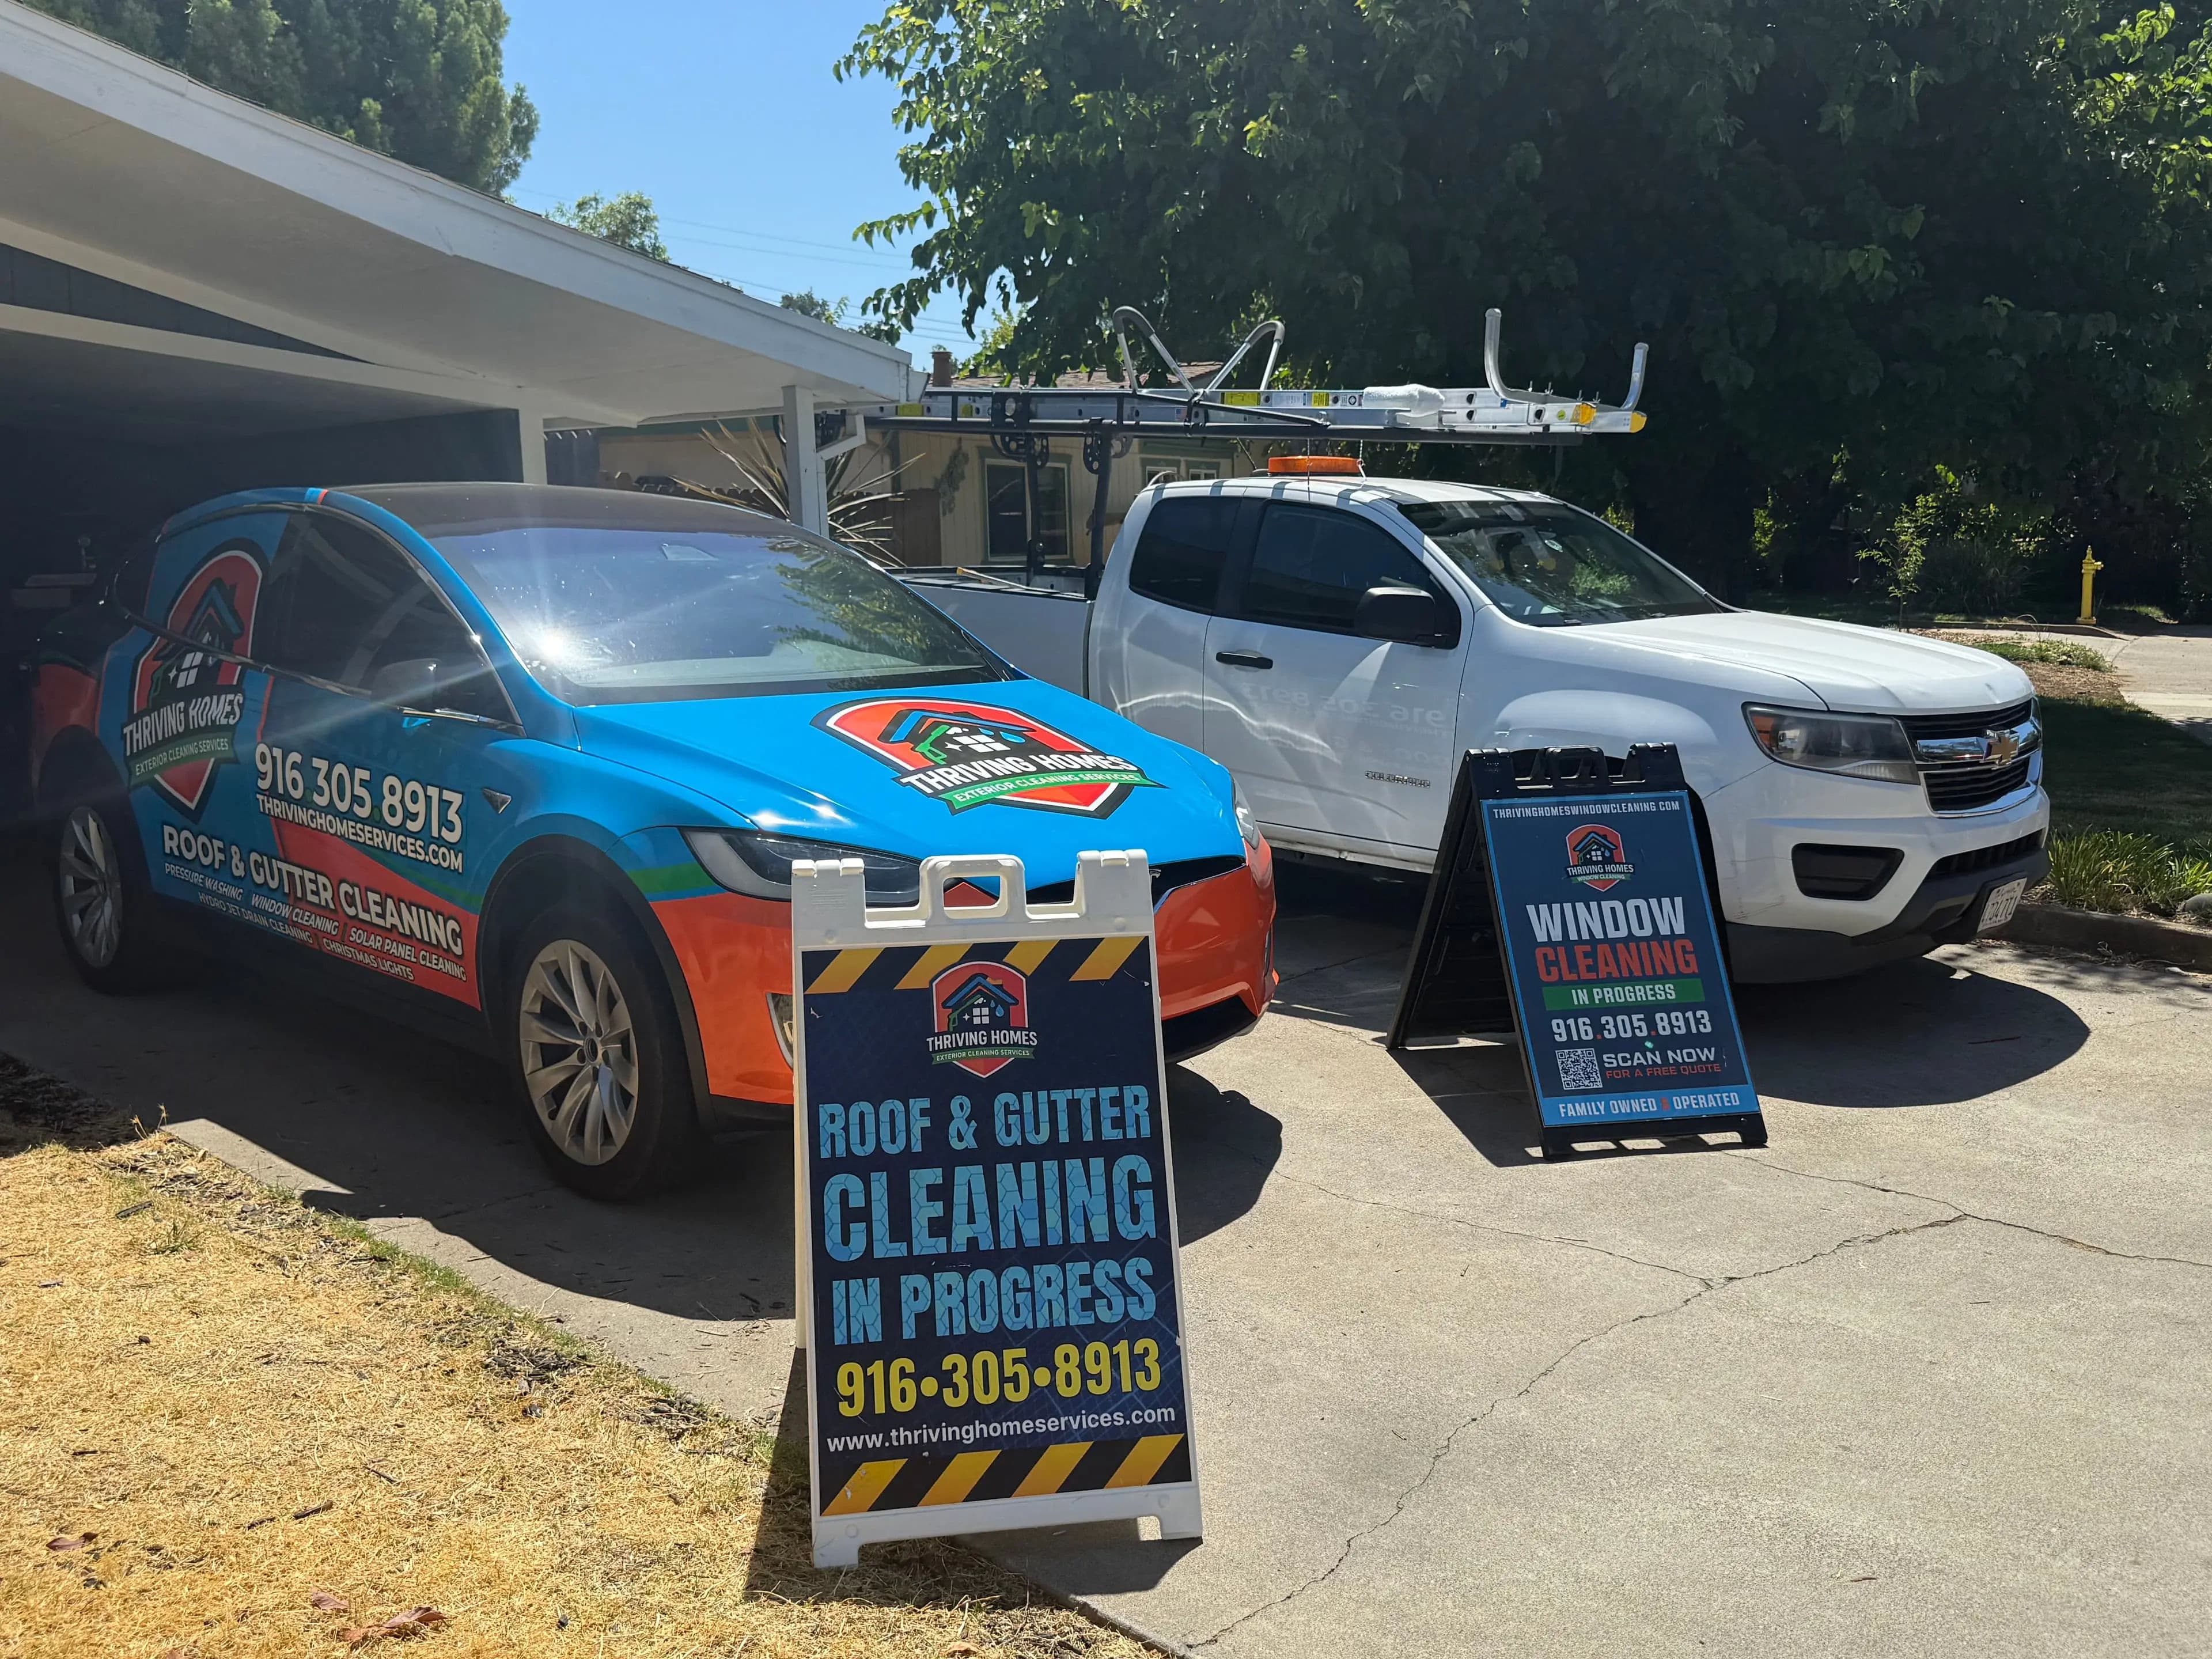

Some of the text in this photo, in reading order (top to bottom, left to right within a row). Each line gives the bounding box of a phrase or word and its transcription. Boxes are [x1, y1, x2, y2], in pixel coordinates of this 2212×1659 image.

[123, 693, 243, 756] THRIVING HOMES
[135, 738, 229, 775] EXTERIOR CLEANING SERVICES
[900, 754, 1138, 794] THRIVING HOMES
[953, 772, 1141, 802] EXTERIOR CLEANING SERVICES
[256, 794, 463, 873] THRIVINGHOMESERVICES.COM
[163, 825, 463, 956] ROOF & GUTTER CLEANING
[1567, 864, 1634, 876] THRIVING HOMES
[165, 863, 467, 982] PRESSURE WASHING WINDOW CLEANING SOLAR PANEL CLEANING
[198, 892, 414, 980] HYDRO JET DRAIN CLEANING CHRISTMAS LIGHTS
[1526, 897, 1685, 942] WINDOW
[1535, 939, 1698, 983] CLEANING
[1571, 984, 1676, 1005] IN PROGRESS
[926, 1030, 1037, 1052] THRIVING HOMES
[1551, 1010, 1712, 1041] 916.305.8913
[937, 1051, 966, 1061] EXTERIOR
[1603, 1047, 1715, 1067] SCAN NOW
[1605, 1063, 1721, 1079] FOR A FREE QUOTE
[818, 1085, 1151, 1159] ROOF & GUTTER
[1559, 1101, 1605, 1118] FAMILY
[1609, 1098, 1657, 1113] OWNED
[1673, 1092, 1740, 1110] OPERATED
[823, 1154, 1157, 1262] CLEANING
[832, 1257, 1157, 1346] IN PROGRESS
[827, 1405, 1176, 1453] www.thrivinghomeservices.com
